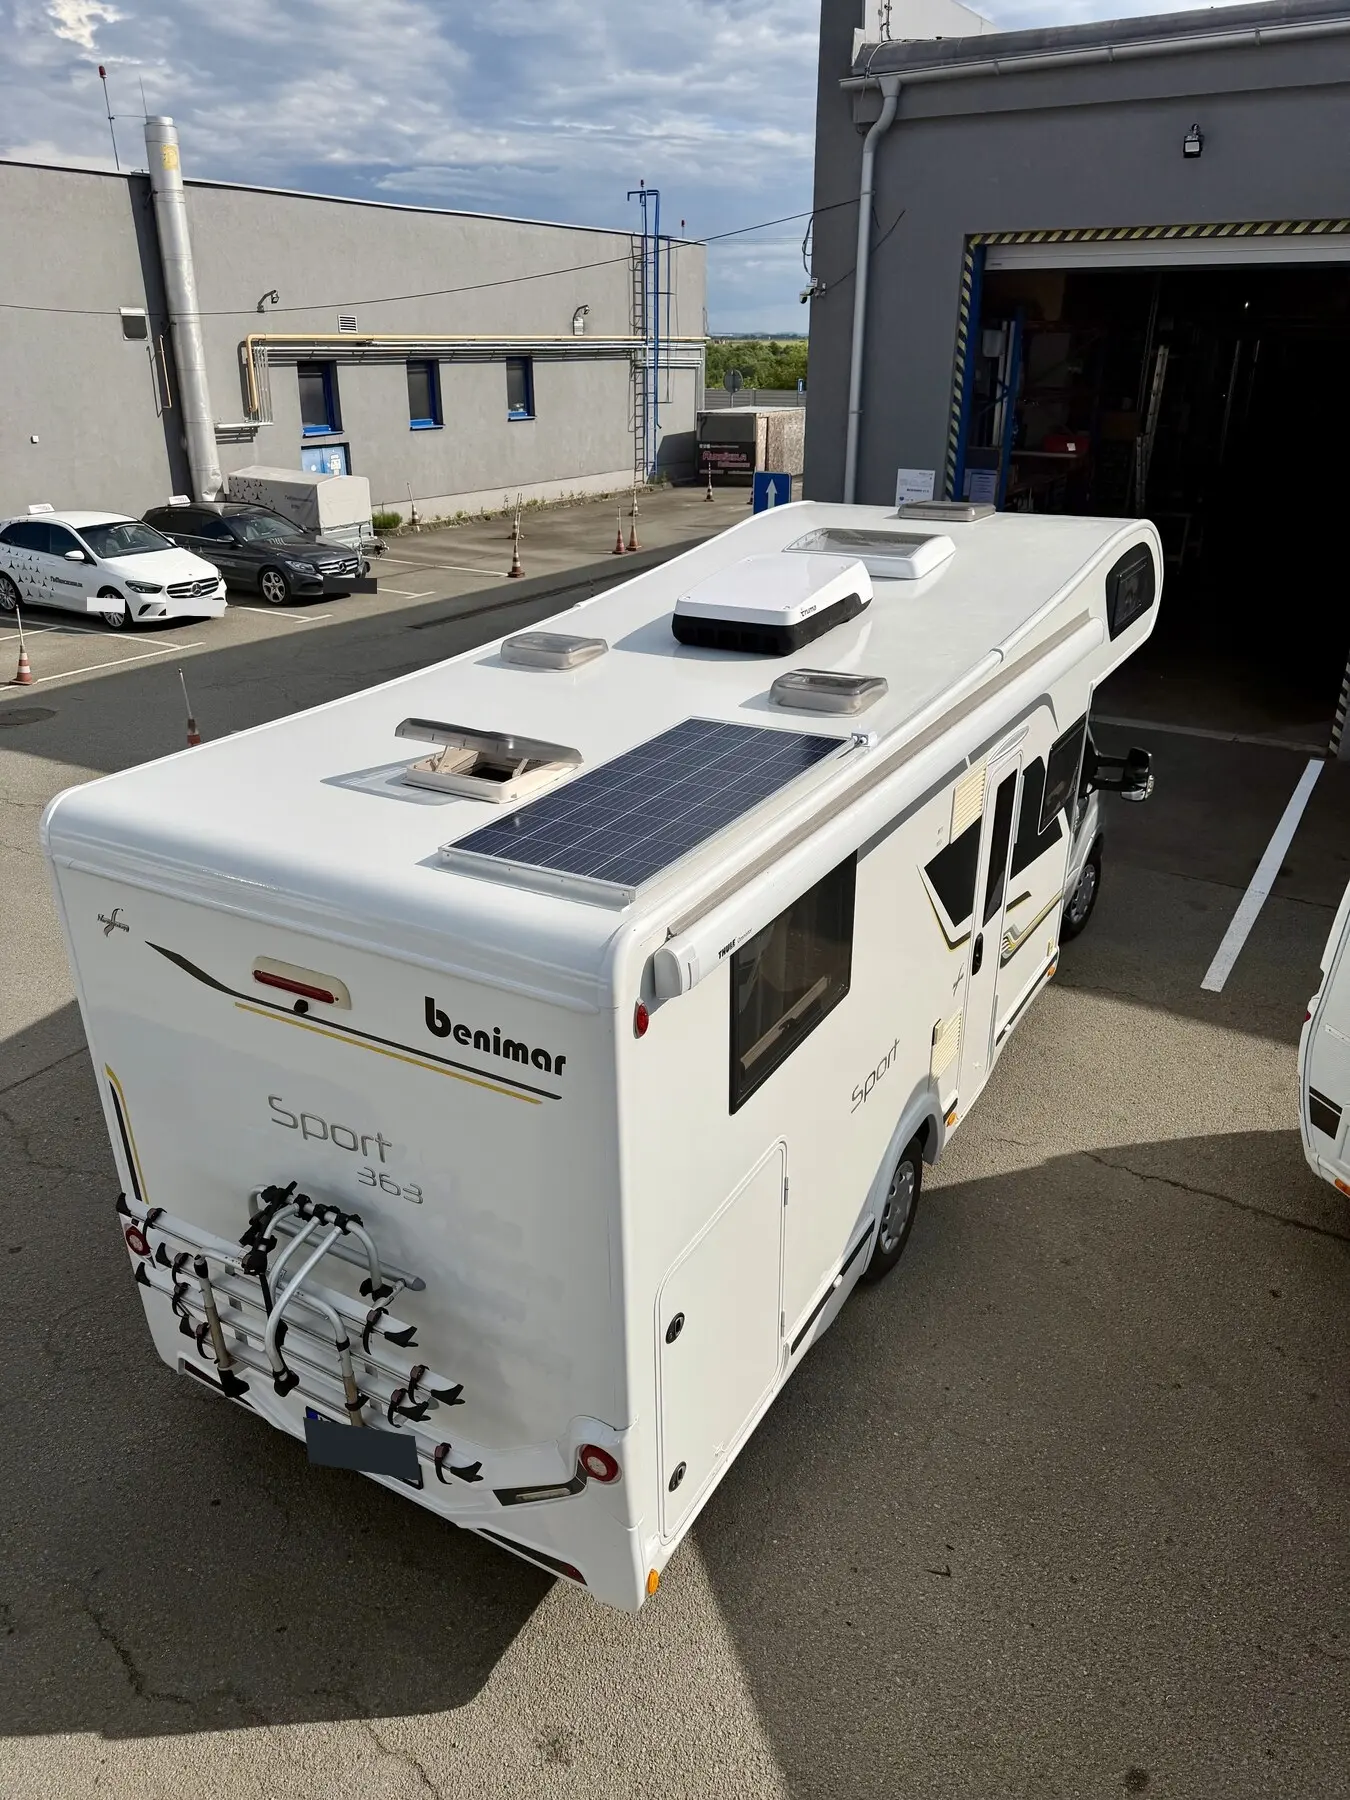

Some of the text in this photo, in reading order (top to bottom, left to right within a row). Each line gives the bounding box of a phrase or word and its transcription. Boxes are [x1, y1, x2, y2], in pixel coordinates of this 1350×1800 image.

[718, 938, 736, 960] THULE
[425, 996, 566, 1076] benimar
[268, 1094, 392, 1163] Sport
[357, 1166, 424, 1205] 363
